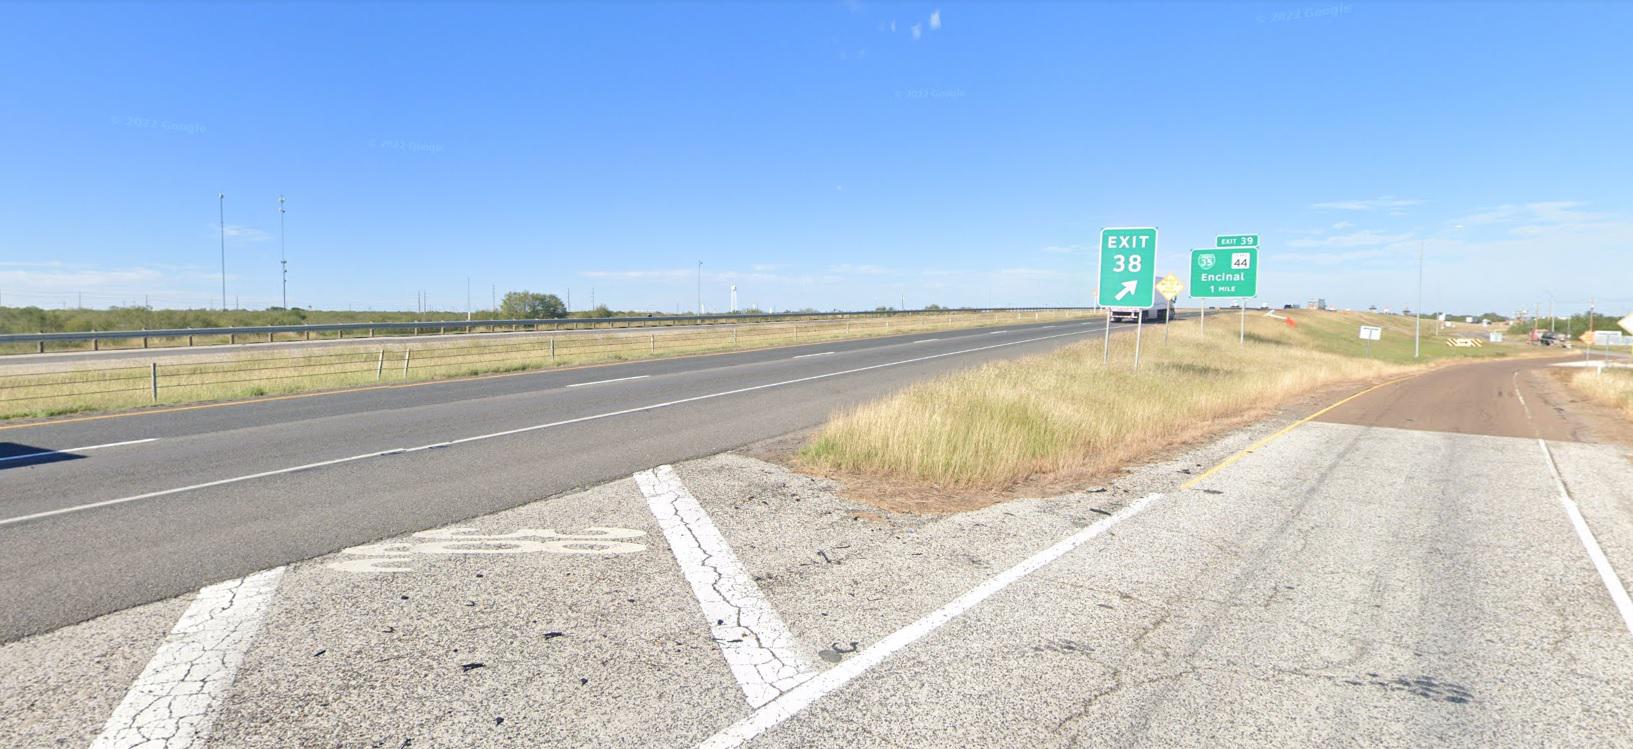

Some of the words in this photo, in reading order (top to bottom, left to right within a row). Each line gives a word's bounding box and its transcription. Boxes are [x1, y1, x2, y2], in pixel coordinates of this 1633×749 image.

[1107, 235, 1150, 249] EXIT
[1240, 236, 1254, 245] 39
[1112, 254, 1142, 273] 38
[1200, 256, 1214, 265] 35
[1233, 258, 1248, 267] 44
[1201, 272, 1245, 282] Encinal
[1209, 285, 1215, 293] 1
